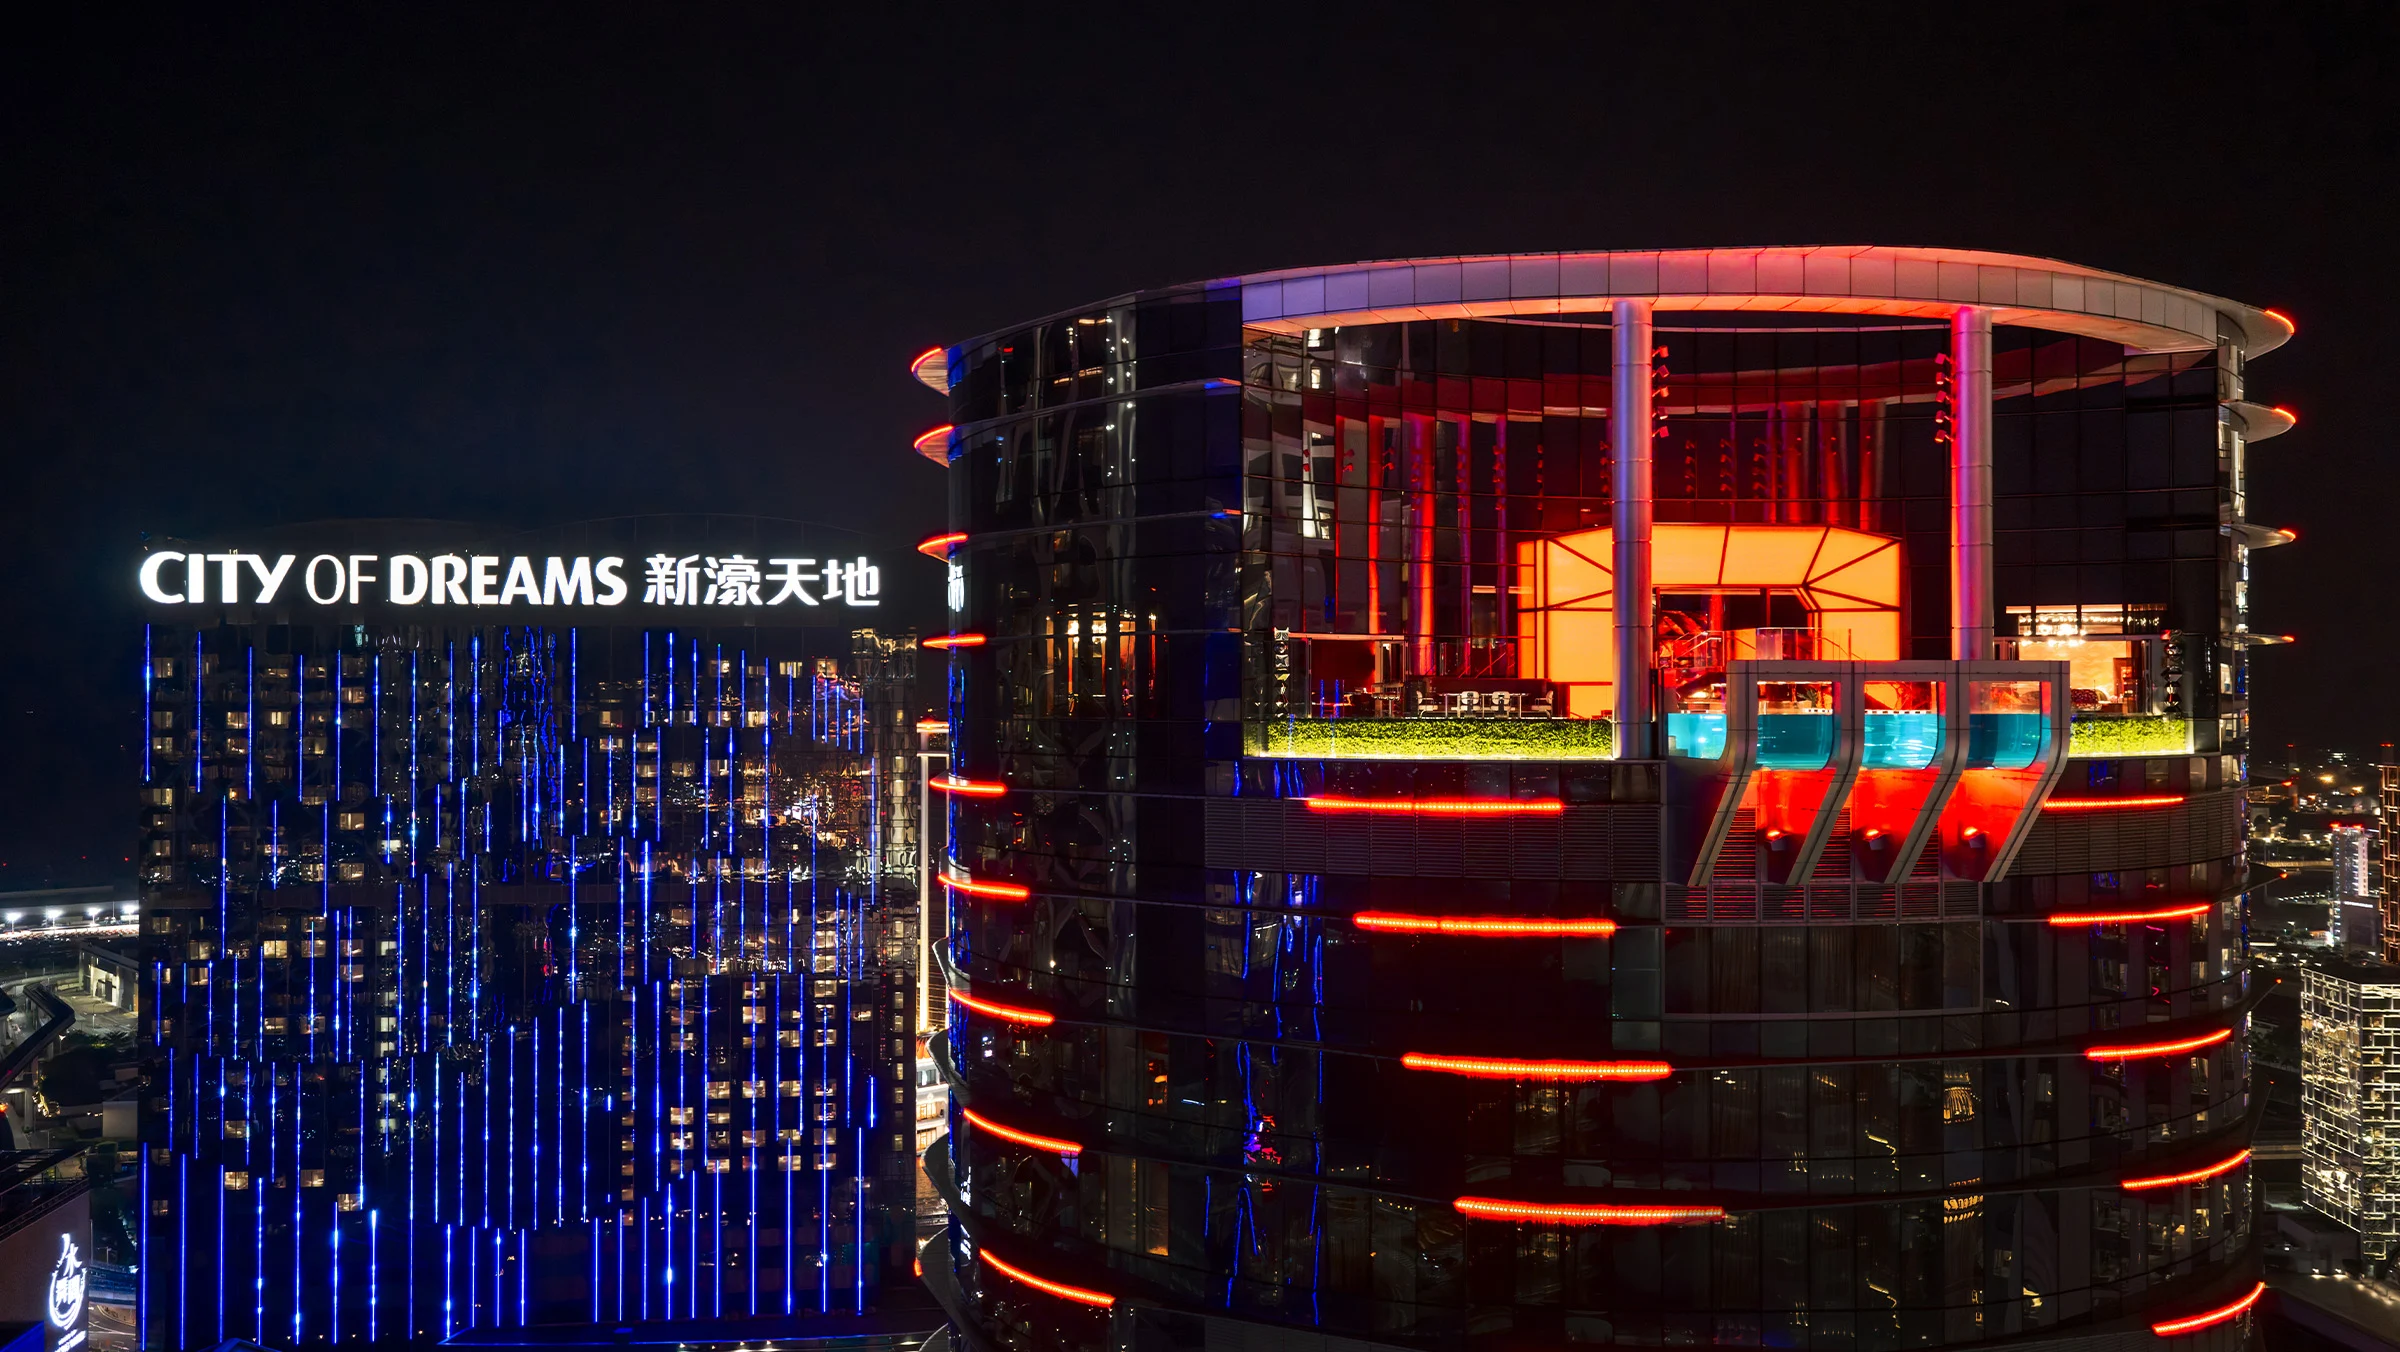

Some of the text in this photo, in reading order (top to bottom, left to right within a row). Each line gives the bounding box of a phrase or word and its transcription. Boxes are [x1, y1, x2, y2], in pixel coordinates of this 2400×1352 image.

[139, 551, 627, 605] CITY OF DREAMS
[642, 553, 880, 606] 新濠天地
